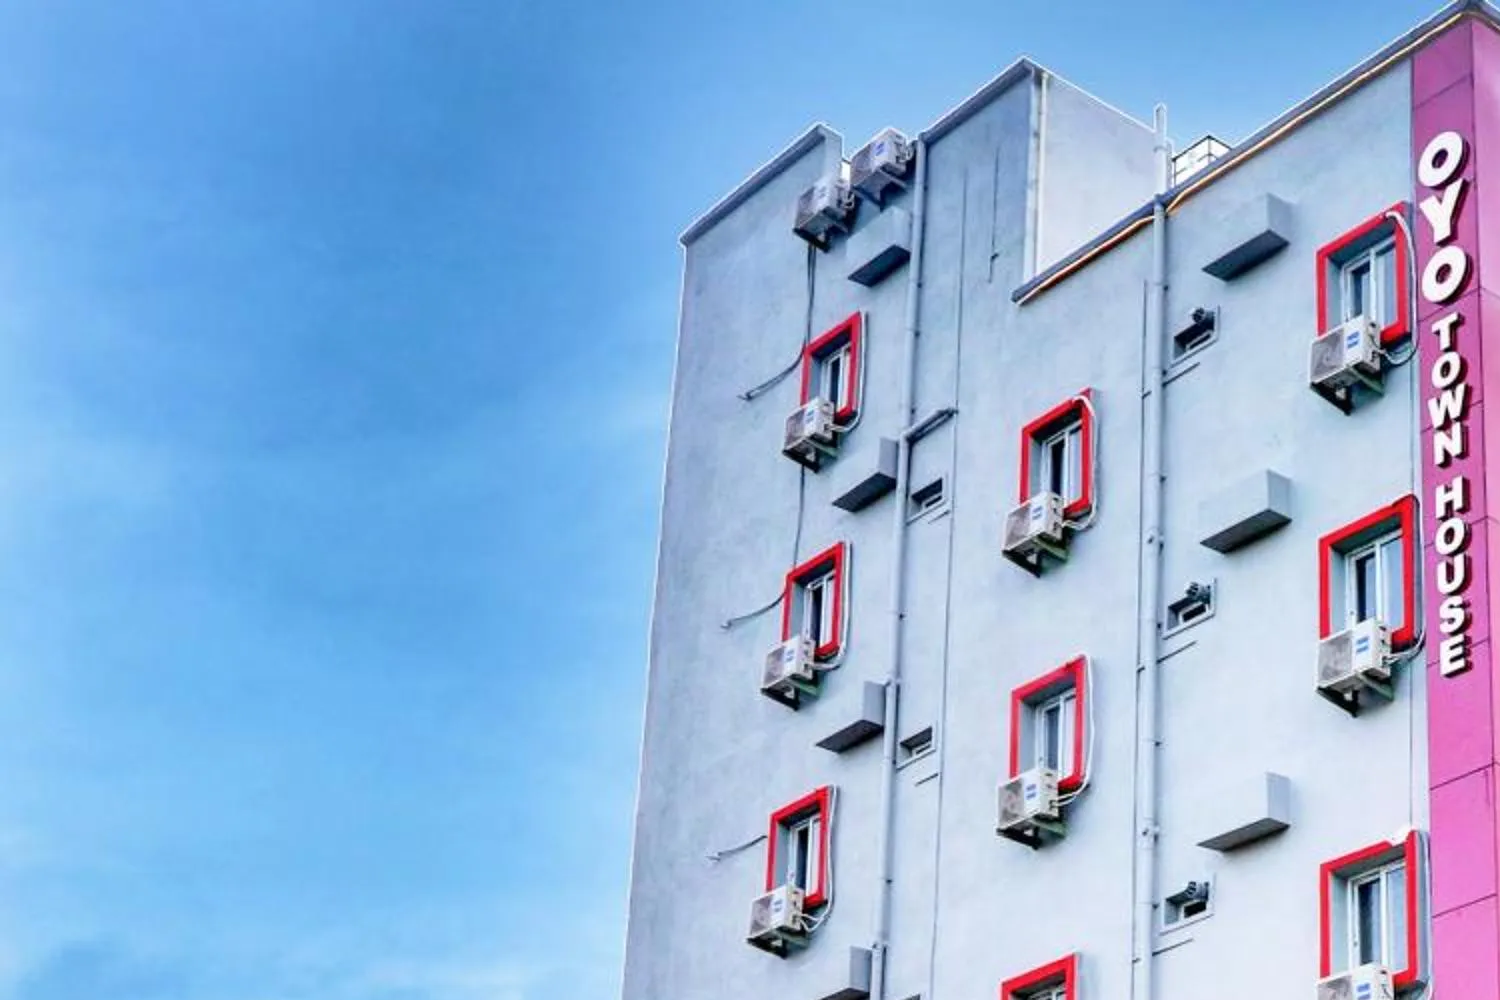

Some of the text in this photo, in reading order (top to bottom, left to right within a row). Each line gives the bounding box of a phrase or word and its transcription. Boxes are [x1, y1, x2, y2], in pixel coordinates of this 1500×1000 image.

[1418, 131, 1473, 678] OYO TOWN HOUSE
